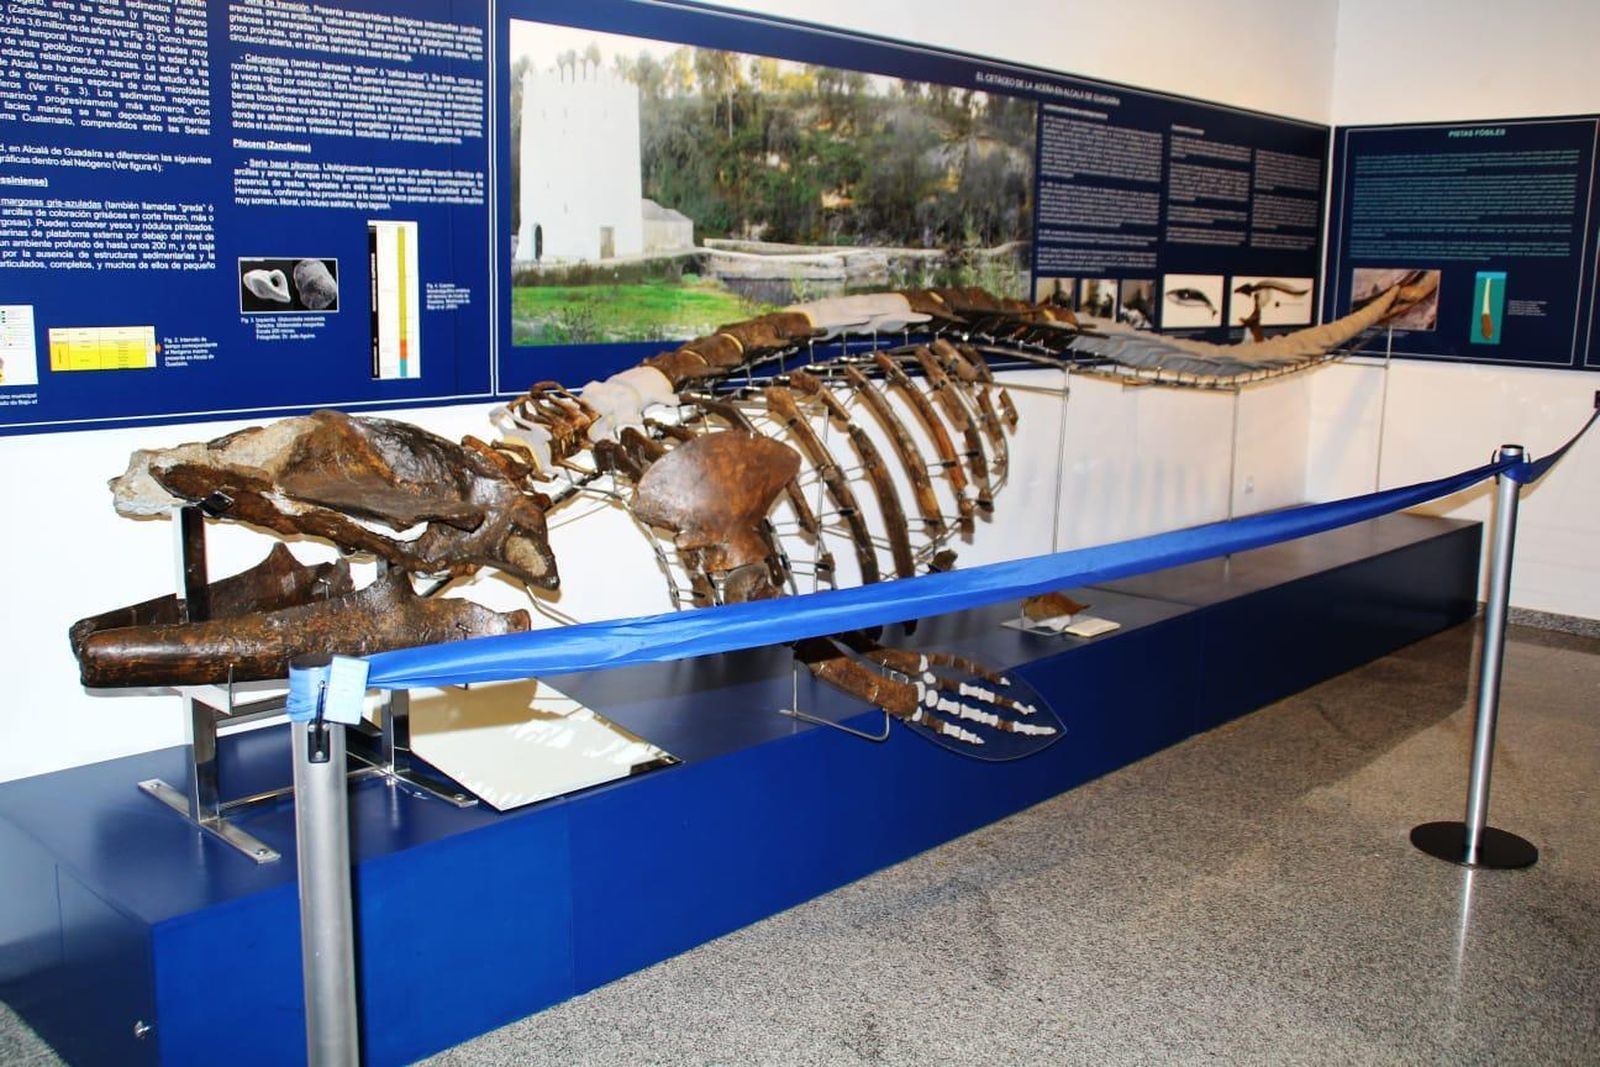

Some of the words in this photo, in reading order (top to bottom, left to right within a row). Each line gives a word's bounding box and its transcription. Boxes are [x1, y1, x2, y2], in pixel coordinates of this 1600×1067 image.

[53, 1, 75, 10] entre
[80, 3, 92, 12] las
[99, 6, 124, 16] Series
[143, 11, 169, 24] Pisos):
[175, 15, 207, 27] Mioceno
[126, 1, 170, 13] sedimentos
[177, 8, 206, 17] marinos
[13, 15, 25, 24] los
[27, 17, 41, 28] 3,6
[43, 20, 77, 31] millones
[91, 25, 111, 35] años
[113, 27, 129, 37] (Ver
[130, 29, 144, 41] Fig.
[147, 31, 157, 42] 2).
[158, 33, 181, 43] Como
[182, 36, 207, 47] hemos
[70, 14, 85, 22] que
[91, 17, 139, 28] representan
[144, 23, 170, 33] rangos
[189, 27, 207, 37] edad
[19, 38, 39, 47] vista
[43, 42, 84, 53] geológico
[107, 48, 138, 58] relación
[168, 54, 186, 63] edad
[29, 28, 67, 40] temporal
[71, 33, 105, 44] humana
[124, 39, 141, 49] trata
[160, 44, 188, 54] edades
[192, 49, 207, 59] muy
[2, 48, 34, 58] edades
[40, 52, 96, 65] relativamente
[102, 59, 139, 69] recientes.
[160, 64, 179, 73] edad
[198, 68, 208, 76] las
[12, 58, 38, 69] Alcalá
[70, 64, 108, 76] deducido
[121, 71, 140, 80] partir
[144, 72, 155, 81] del
[159, 74, 186, 84] estudio
[25, 71, 83, 84] determinadas
[88, 79, 123, 88] especies
[142, 84, 161, 92] unos
[165, 85, 209, 96] microfósiles
[0, 91, 37, 100] marinos
[45, 96, 118, 107] progresivamente
[126, 101, 143, 110] más
[150, 105, 186, 113] someros.
[194, 106, 210, 115] Con
[30, 82, 47, 92] (Ver
[55, 84, 70, 95] Fig.
[79, 86, 90, 97] 3).
[98, 88, 112, 97] Los
[120, 91, 165, 102] sedimentos
[173, 96, 209, 107] neógenos
[4, 101, 30, 111] facies
[38, 105, 72, 114] marinas
[96, 108, 111, 117] han
[118, 110, 161, 121] depositado
[168, 115, 210, 125] sedimentos
[22, 113, 75, 127] Cuaternario,
[81, 120, 137, 129] comprendidos
[143, 123, 162, 131] entre
[169, 124, 179, 132] las
[22, 145, 48, 154] Alcalá
[117, 151, 159, 161] diferencian
[161, 153, 172, 162] las
[174, 154, 212, 164] siguientes
[32, 156, 59, 165] dentro
[60, 158, 72, 166] del
[75, 158, 111, 170] Neógeno
[113, 161, 129, 171] (Ver
[130, 162, 152, 172] figura
[1, 199, 44, 207] margosas
[47, 199, 101, 208] gris-azuladas
[105, 200, 138, 210] (también
[142, 201, 176, 210] llamadas
[2, 207, 32, 215] arcillas
[49, 208, 91, 217] coloración
[94, 210, 127, 220] grisácea
[164, 212, 188, 223] fresco,
[191, 213, 206, 221] más
[36, 218, 68, 227] Pueden
[71, 220, 106, 228] contener
[110, 222, 132, 230] yesos
[143, 221, 172, 229] nódulos
[175, 222, 213, 232] piritizados.
[46, 229, 89, 239] plataforma
[93, 230, 123, 238] externa
[126, 233, 139, 241] por
[142, 231, 168, 241] debajo
[171, 231, 181, 239] del
[185, 232, 202, 240] nivel
[13, 239, 52, 247] ambiente
[55, 240, 91, 249] profundo
[106, 240, 128, 248] hasta
[152, 241, 166, 249] 200
[199, 242, 215, 252] baja
[36, 250, 73, 258] ausencia
[94, 250, 138, 258] estructuras
[143, 251, 194, 259] sedimentarias
[50, 260, 94, 270] completos,
[106, 260, 135, 268] muchos
[151, 260, 168, 268] ellos
[184, 261, 215, 271] pequeño
